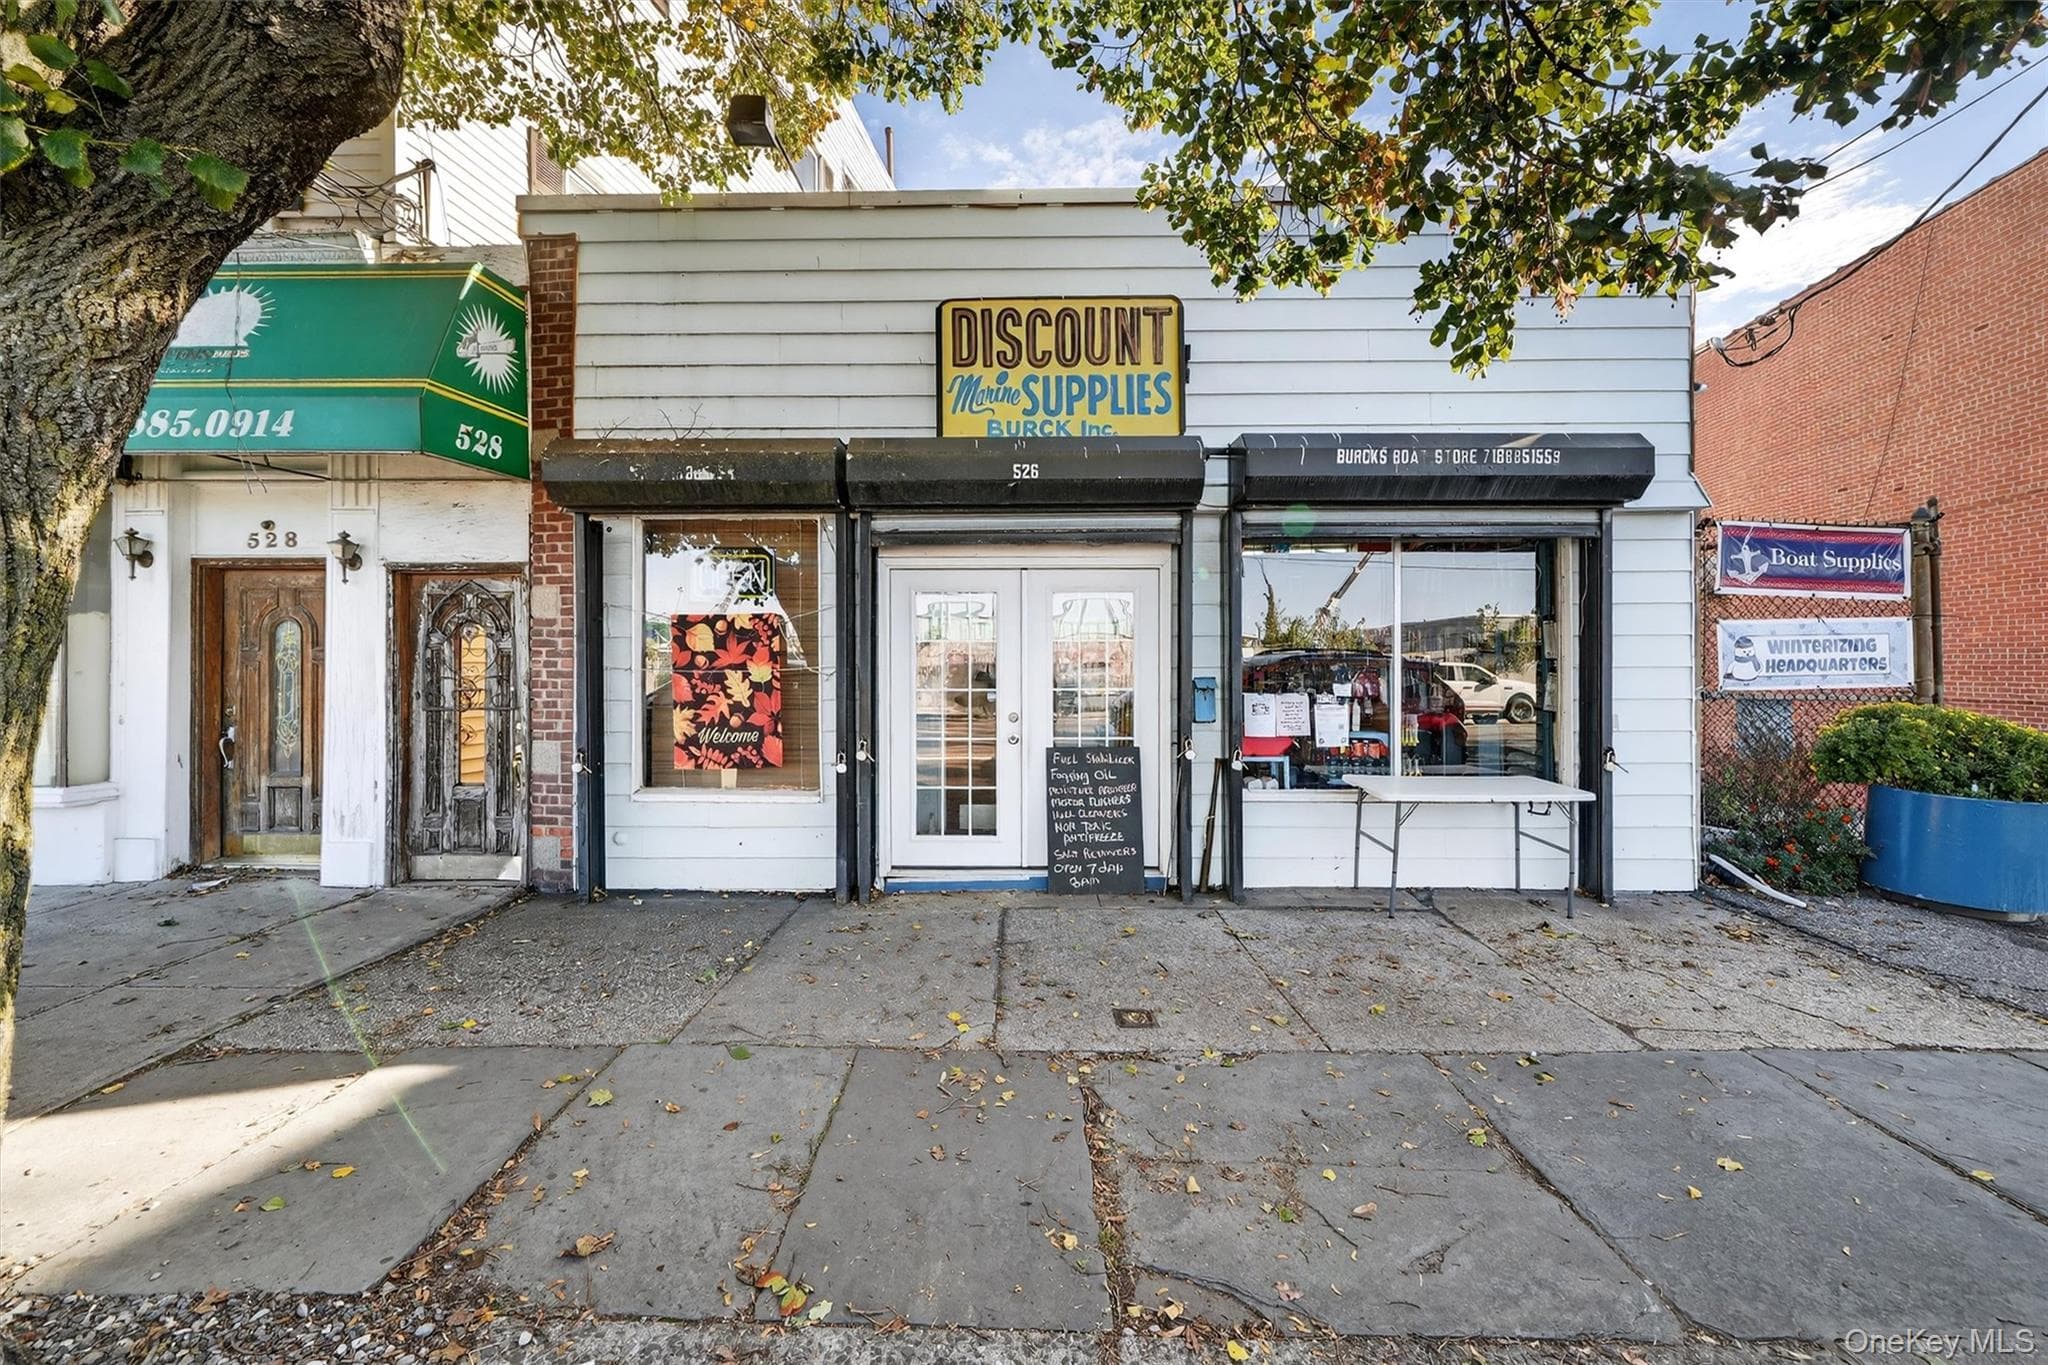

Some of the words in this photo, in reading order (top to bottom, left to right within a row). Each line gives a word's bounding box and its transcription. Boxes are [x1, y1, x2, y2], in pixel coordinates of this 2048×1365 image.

[951, 306, 1173, 368] DISCOUNT
[946, 371, 1023, 415] Marine
[1021, 372, 1172, 417] SUPPLIES
[986, 419, 1071, 437] BURCK
[1081, 420, 1119, 437] Inc.
[455, 423, 502, 460] 528
[1336, 448, 1388, 465] BURCKS
[1435, 449, 1478, 464] STORE
[1013, 464, 1039, 479] 526
[247, 531, 298, 549] 528
[1770, 548, 1818, 568] Boat
[1823, 550, 1902, 573] Supplies
[1767, 638, 1877, 655] WINTERIZING
[1765, 656, 1887, 674] HEADQUARTERS
[698, 727, 759, 745] Welcome
[1086, 864, 1097, 875] 7
